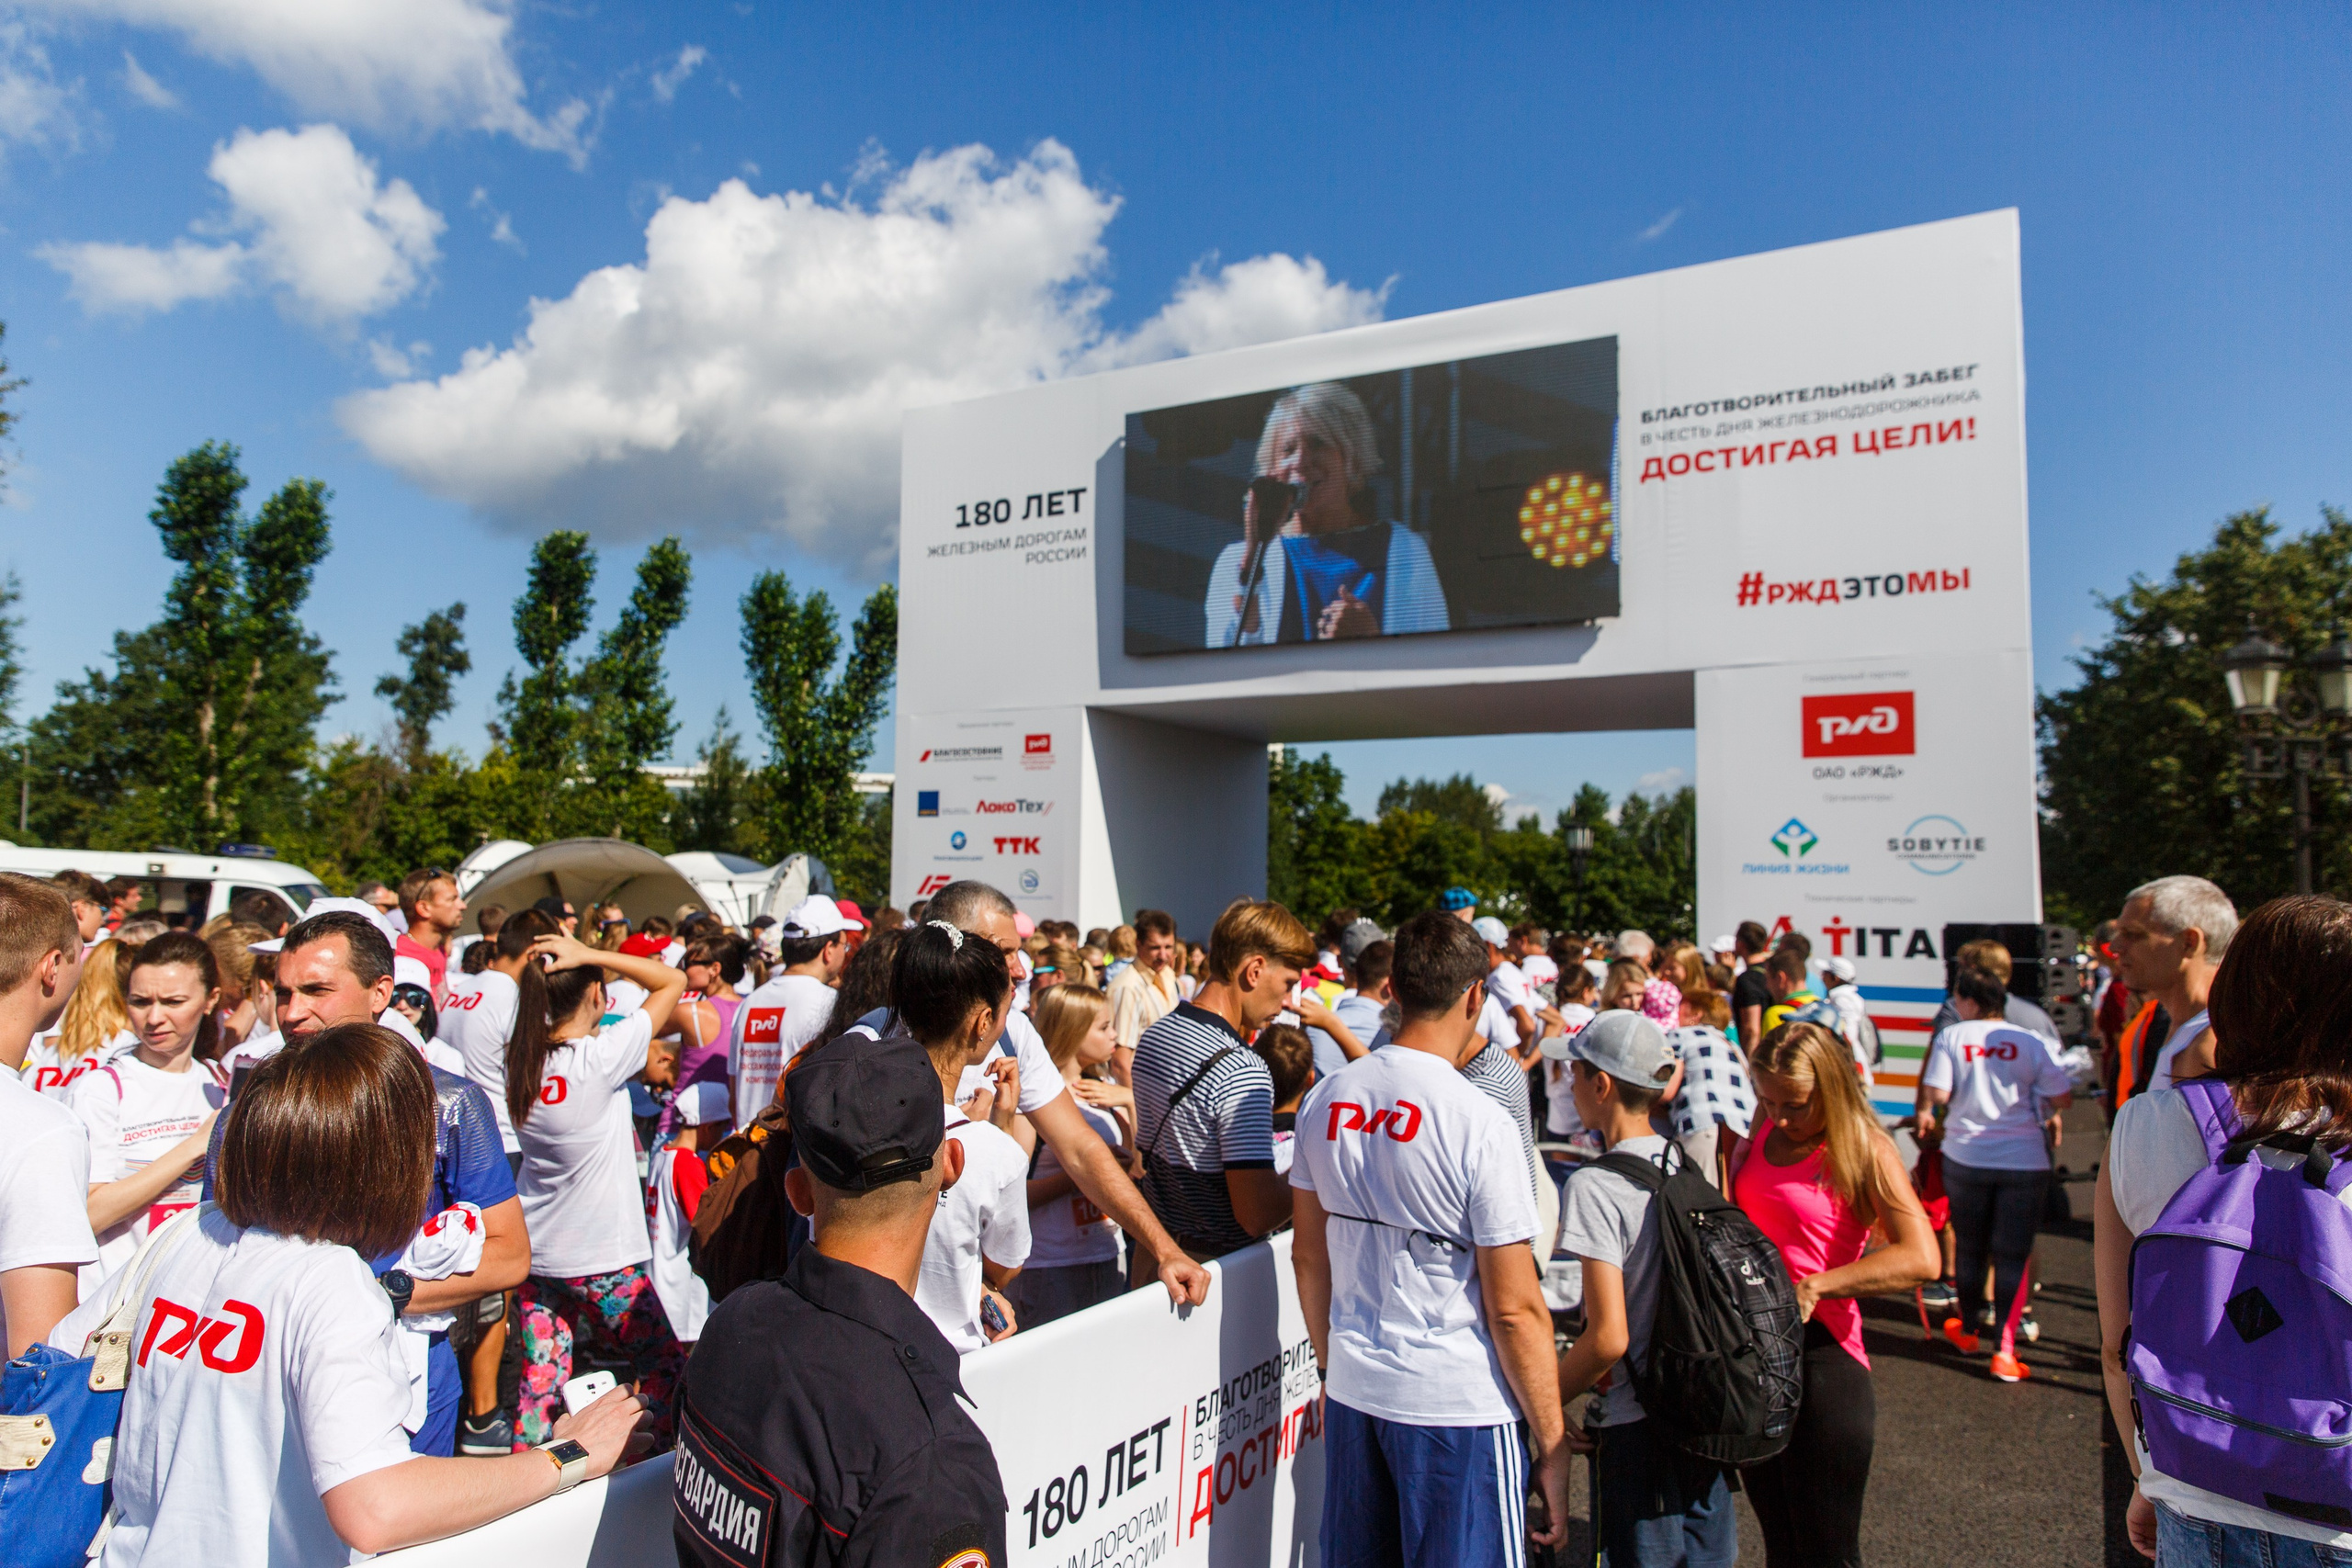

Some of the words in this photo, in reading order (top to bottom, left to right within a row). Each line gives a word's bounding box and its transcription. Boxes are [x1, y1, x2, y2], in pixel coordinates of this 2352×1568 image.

[1641, 373, 1895, 423] БЛАГОТВОРИТЕЛЬНЫЙ
[1903, 363, 1980, 389] ЗАБЕГ
[1641, 432, 1652, 446] В
[1656, 425, 1712, 443] ЧЕСТЬ
[1714, 419, 1753, 437] ДНЯ
[1758, 389, 1981, 430] ЖЕЛЕЗНОДОРОЖНИКА
[1640, 434, 1838, 484] ДОСТИГАЯ
[1853, 417, 1976, 456] ЦЕЛИ!
[956, 499, 1011, 528] 180
[1022, 487, 1087, 520] ЛЕТ
[927, 537, 1010, 558] ЖЕЛЕЗНЫМ
[1014, 527, 1087, 548] ДОРОГАМ
[1025, 547, 1087, 565] РОССИИ
[1813, 766, 1846, 780] ОАО
[993, 836, 1041, 855] ТТК
[1887, 837, 1986, 852] SOBYTIE
[1742, 863, 1792, 874] ЛИНИЯ
[1795, 863, 1850, 874] ЖИЗНИ
[1193, 1433, 1204, 1461] В
[1208, 1406, 1251, 1449] ЧЕСТЬ
[1253, 1386, 1282, 1430] ДНЯ
[1283, 1364, 1321, 1405] ЖЕЛЕ
[1023, 1464, 1089, 1550] 180
[1098, 1416, 1171, 1509] ЛЕТ
[1091, 1495, 1168, 1568] ДОРОГАМ
